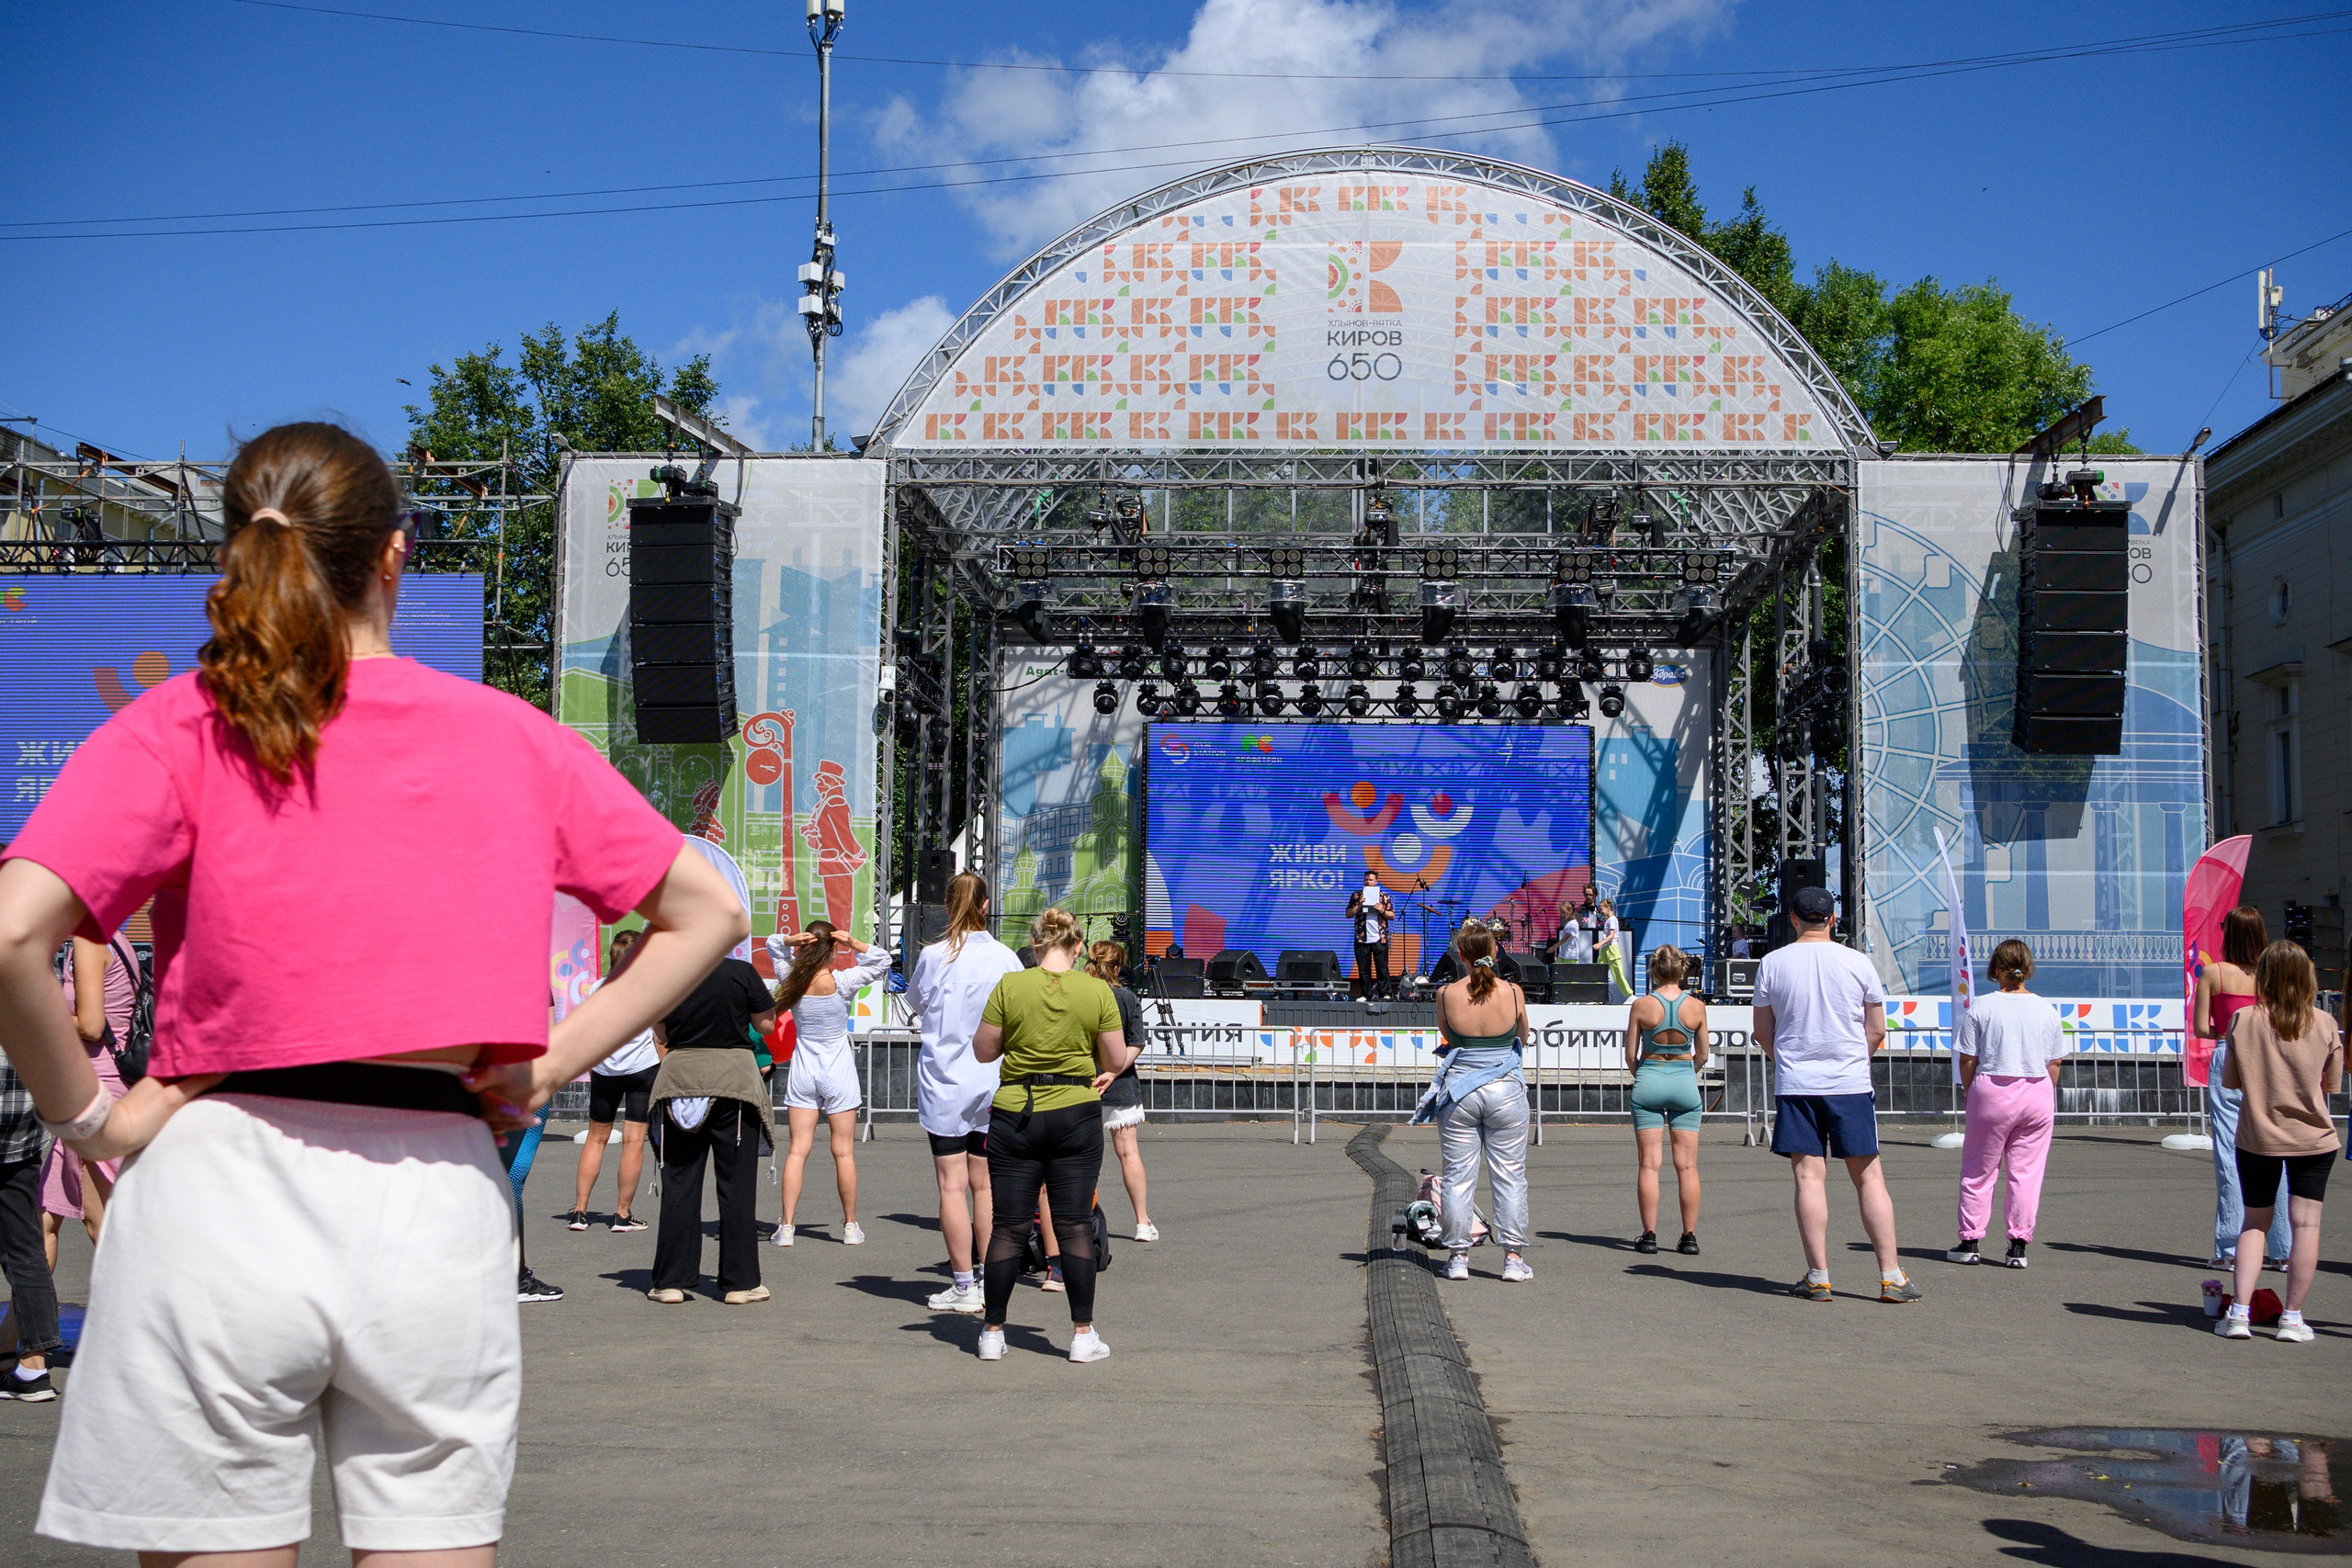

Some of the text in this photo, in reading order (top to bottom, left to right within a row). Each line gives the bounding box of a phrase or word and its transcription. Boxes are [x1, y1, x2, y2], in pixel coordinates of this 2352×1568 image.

[1327, 331, 1403, 346] КИРОВ
[1327, 353, 1403, 381] 650
[606, 558, 630, 577] 65
[1269, 843, 1346, 863] ЖИВИ
[1268, 869, 1345, 889] ЯРКО!
